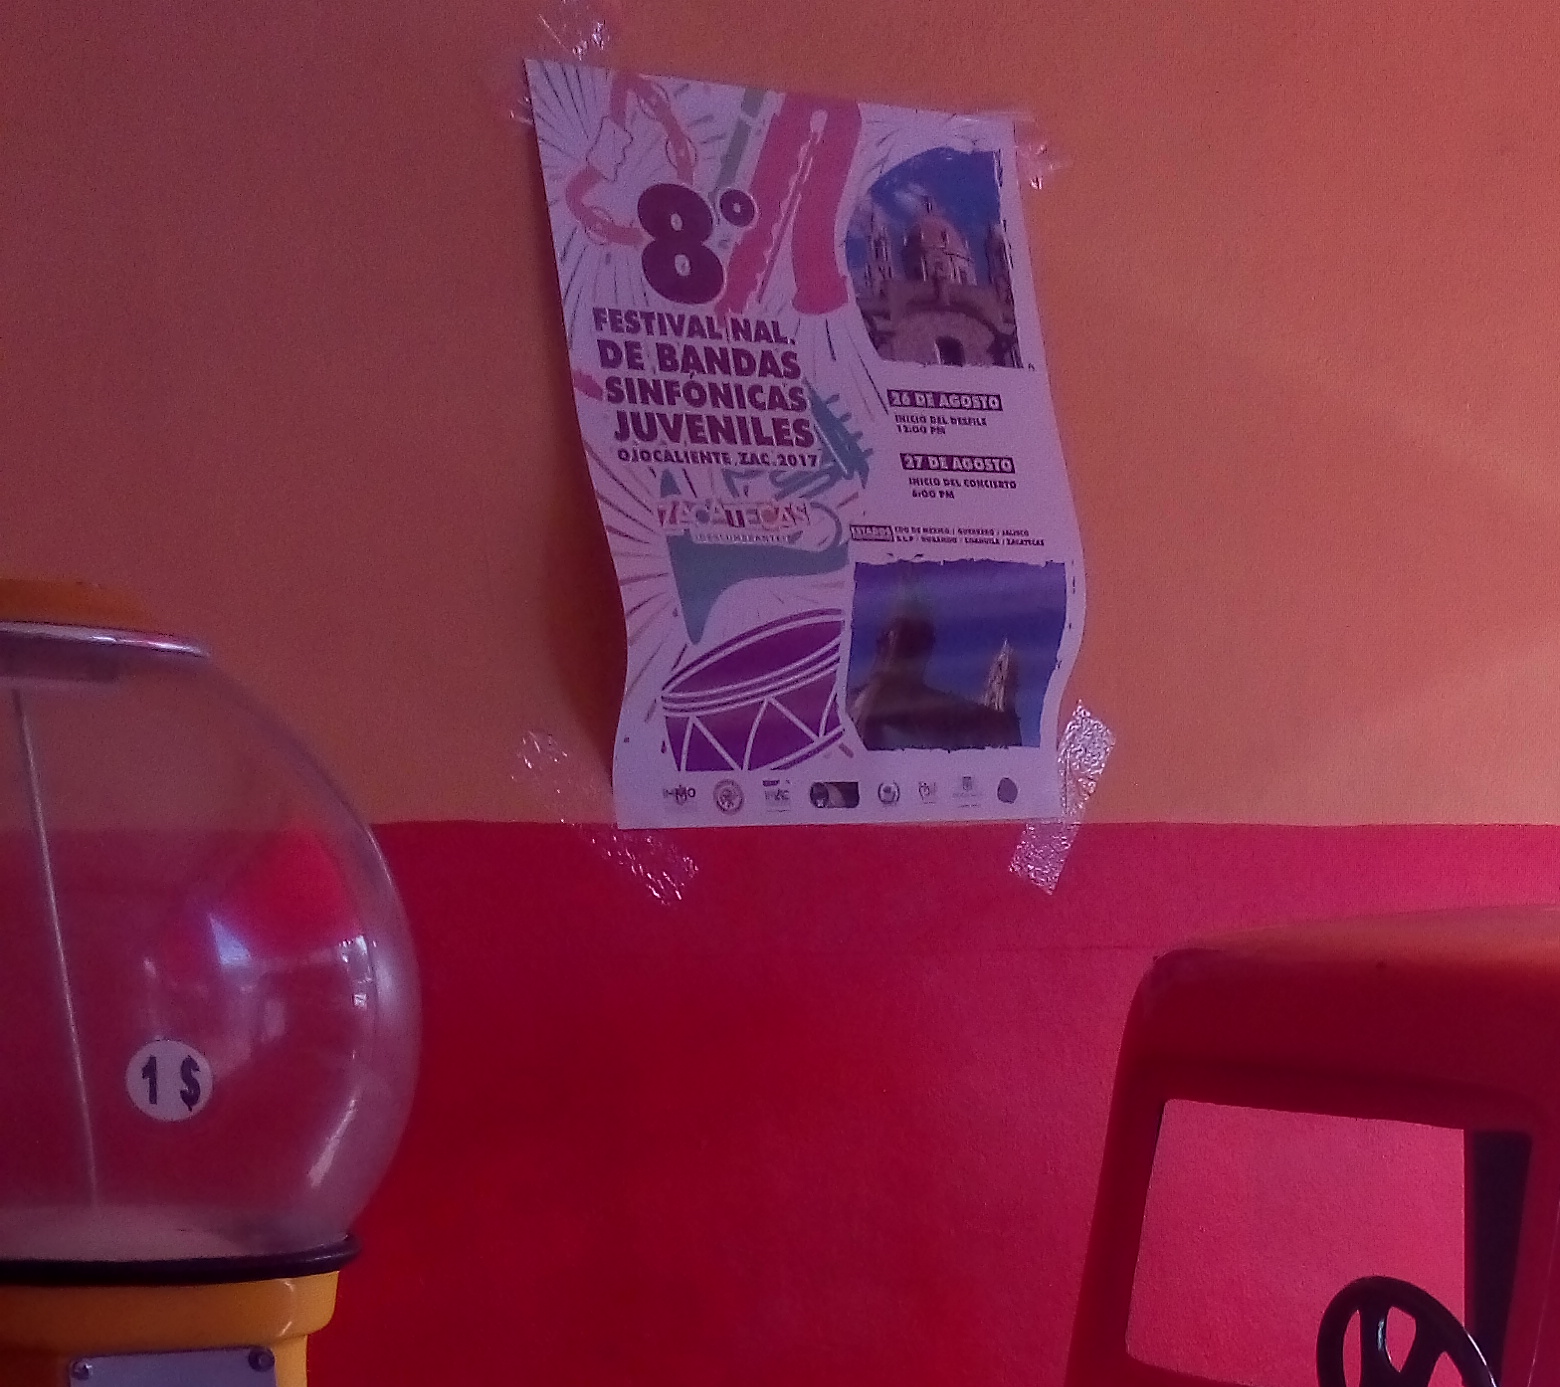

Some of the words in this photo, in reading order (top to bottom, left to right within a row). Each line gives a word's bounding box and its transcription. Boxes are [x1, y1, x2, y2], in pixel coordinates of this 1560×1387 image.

[592, 307, 722, 340] FESTIVAL
[731, 318, 796, 345] NAL.
[597, 338, 645, 371] DE
[656, 342, 801, 379] BANDAS
[914, 392, 935, 407] DE
[939, 393, 1000, 409] AGOSTO
[614, 409, 815, 448] JUVENILES
[777, 453, 818, 467] 2017
[904, 454, 923, 469] 27
[927, 456, 948, 470] DE
[952, 457, 1013, 472] AGOSTO
[943, 478, 961, 487] DEL
